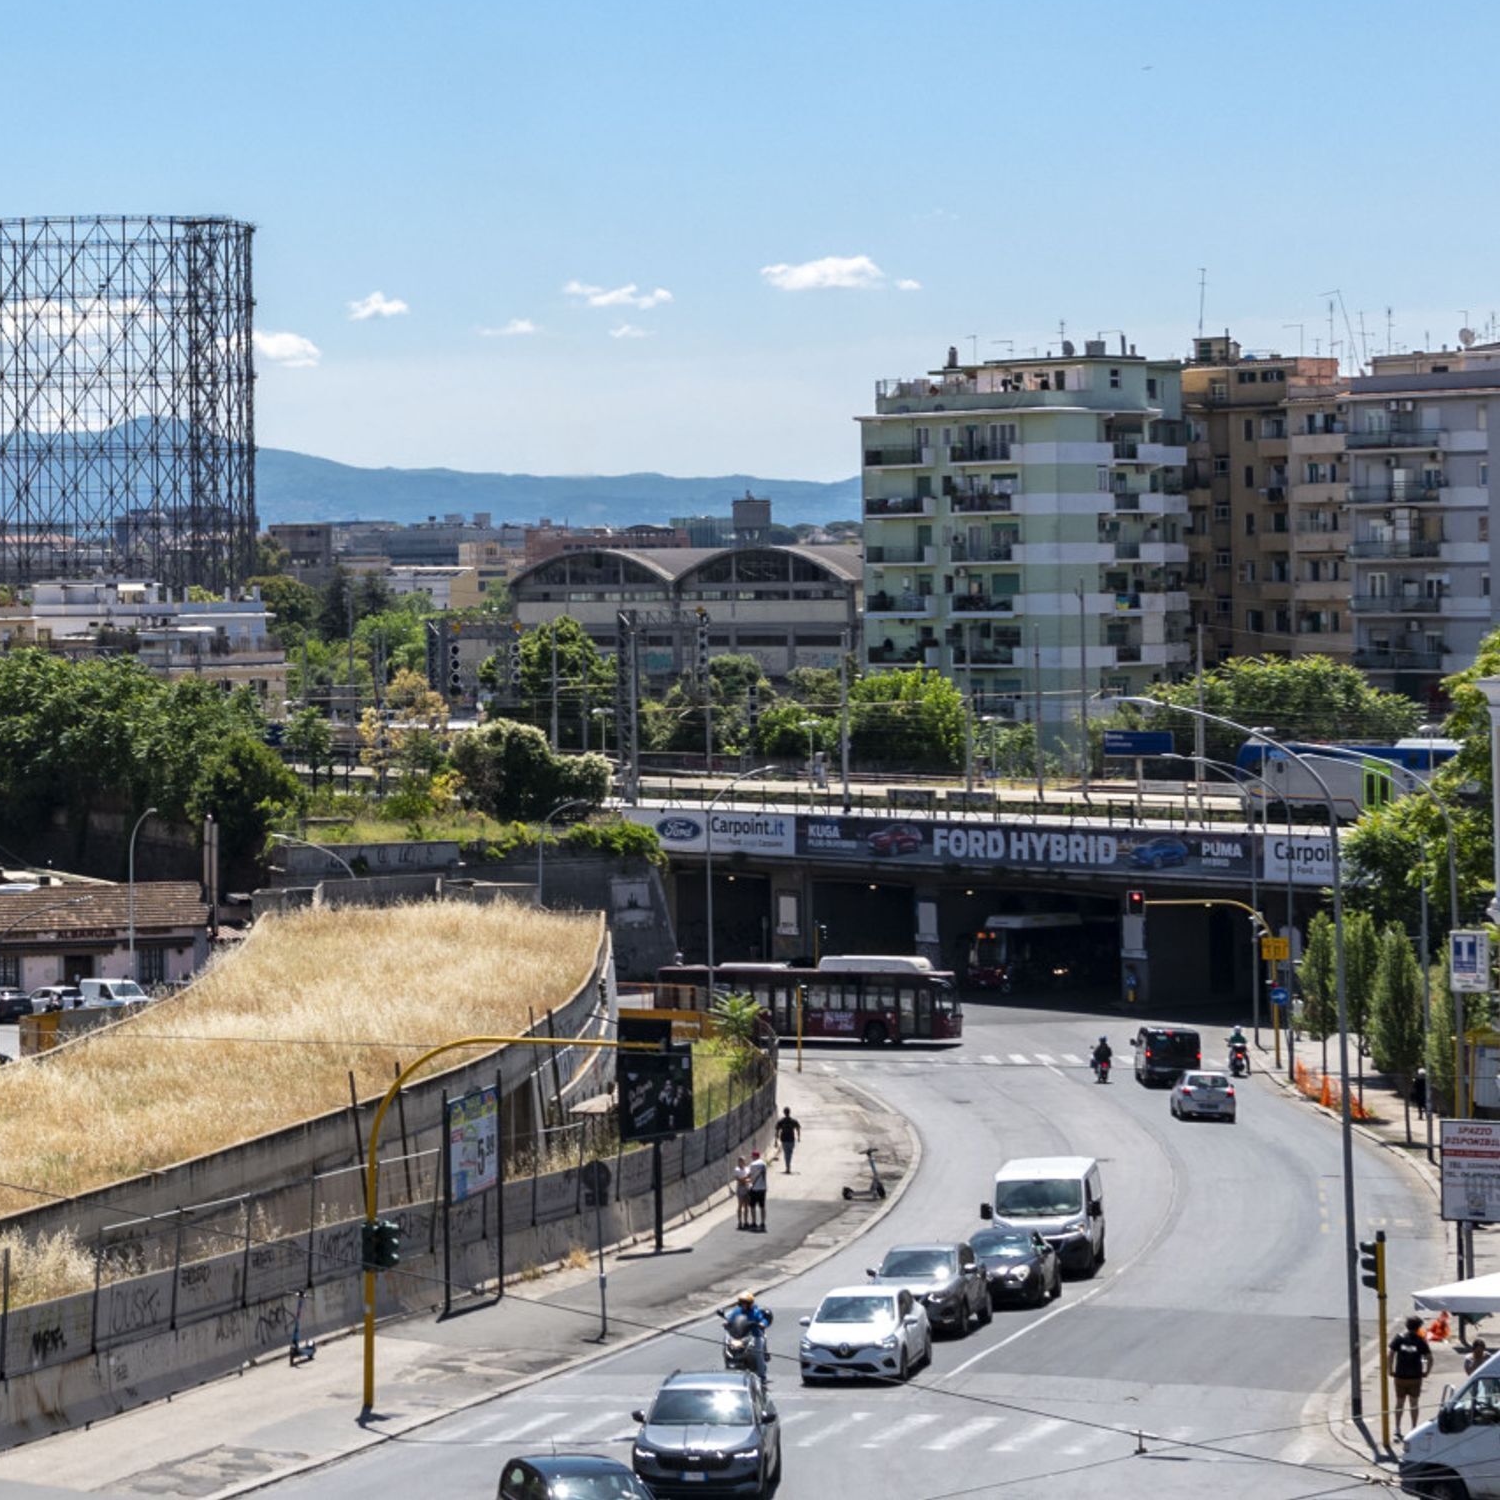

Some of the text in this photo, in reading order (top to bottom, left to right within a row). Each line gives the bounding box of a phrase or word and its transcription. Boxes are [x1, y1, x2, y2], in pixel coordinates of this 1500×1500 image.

[664, 820, 693, 838] Ford
[711, 816, 785, 837] Carpoint.it
[808, 824, 840, 839] KUGA
[933, 828, 1118, 865] FORD HYBRID
[1201, 841, 1243, 858] PUMA
[1274, 841, 1330, 865] Carpoi
